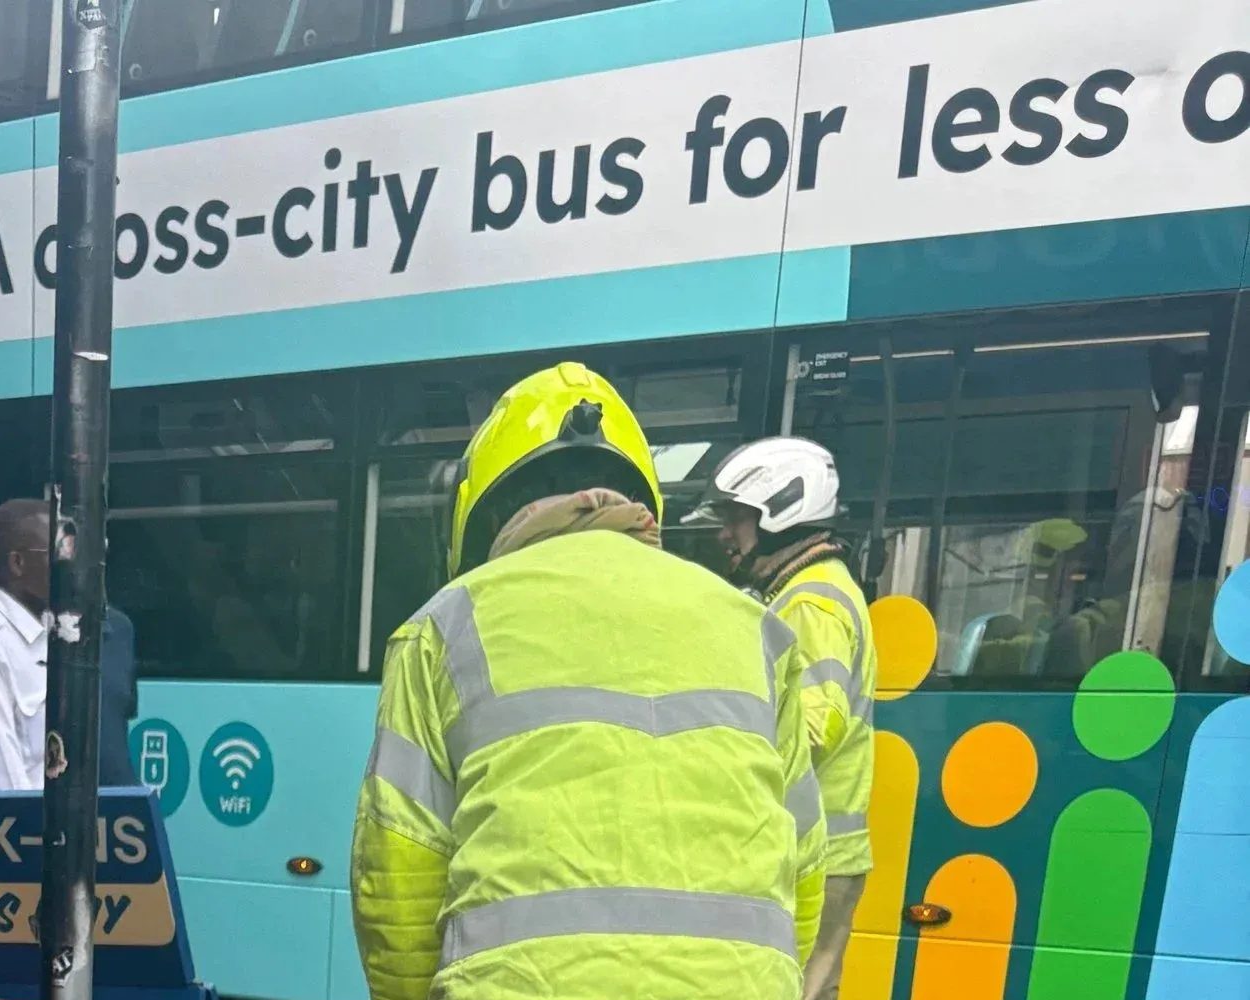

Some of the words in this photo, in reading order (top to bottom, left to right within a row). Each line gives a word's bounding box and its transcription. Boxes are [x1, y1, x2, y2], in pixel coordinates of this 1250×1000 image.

[34, 147, 438, 289] coss-city
[471, 131, 646, 233] bus
[685, 94, 847, 205] for
[897, 64, 1136, 179] less
